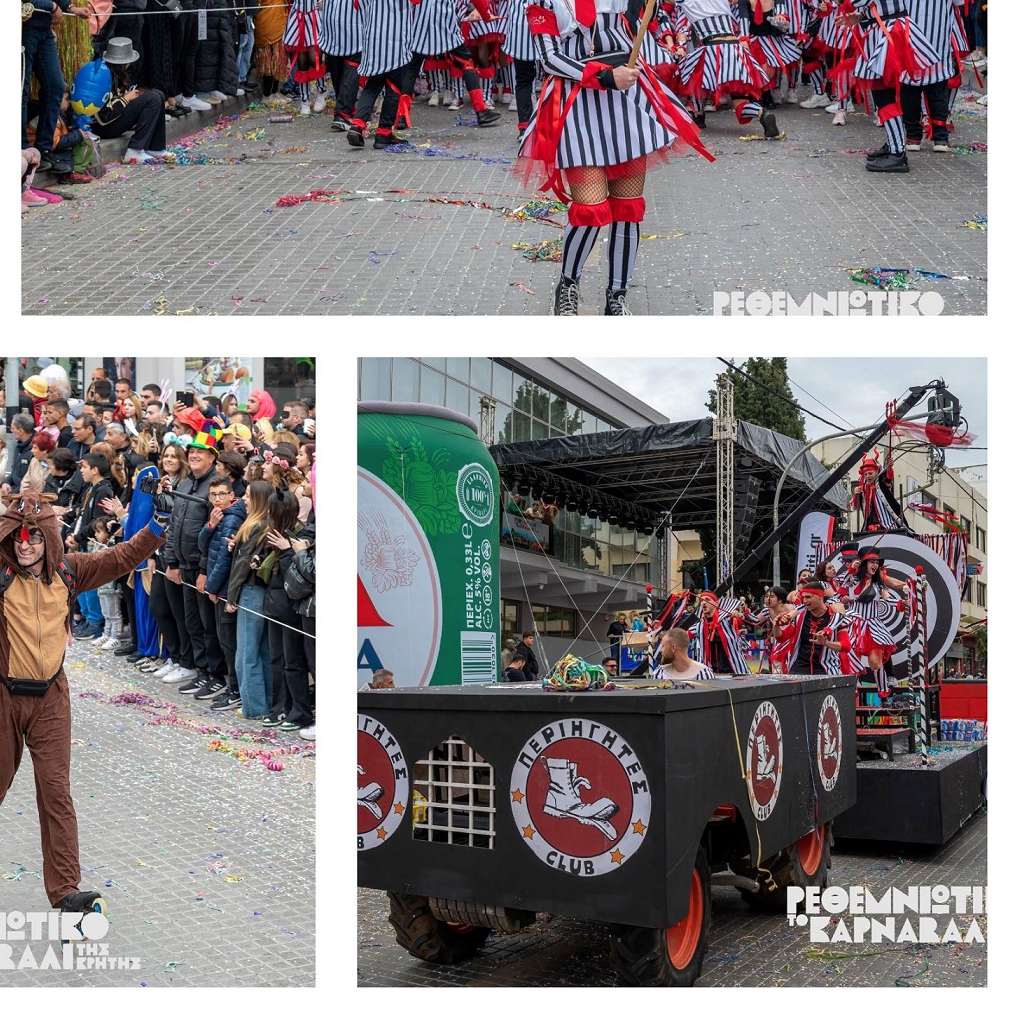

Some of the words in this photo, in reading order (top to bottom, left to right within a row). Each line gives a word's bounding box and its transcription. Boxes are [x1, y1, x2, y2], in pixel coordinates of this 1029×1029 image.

[464, 541, 474, 576] 0,33L
[473, 545, 481, 574] VOL.
[474, 577, 482, 598] 5%
[466, 578, 475, 629] ΠΕΡΙΕΧ.
[475, 601, 483, 629] ALC.
[517, 719, 649, 795] ΠΕΡΙΗΓΗΤΕΣ
[546, 850, 595, 876] CLUB
